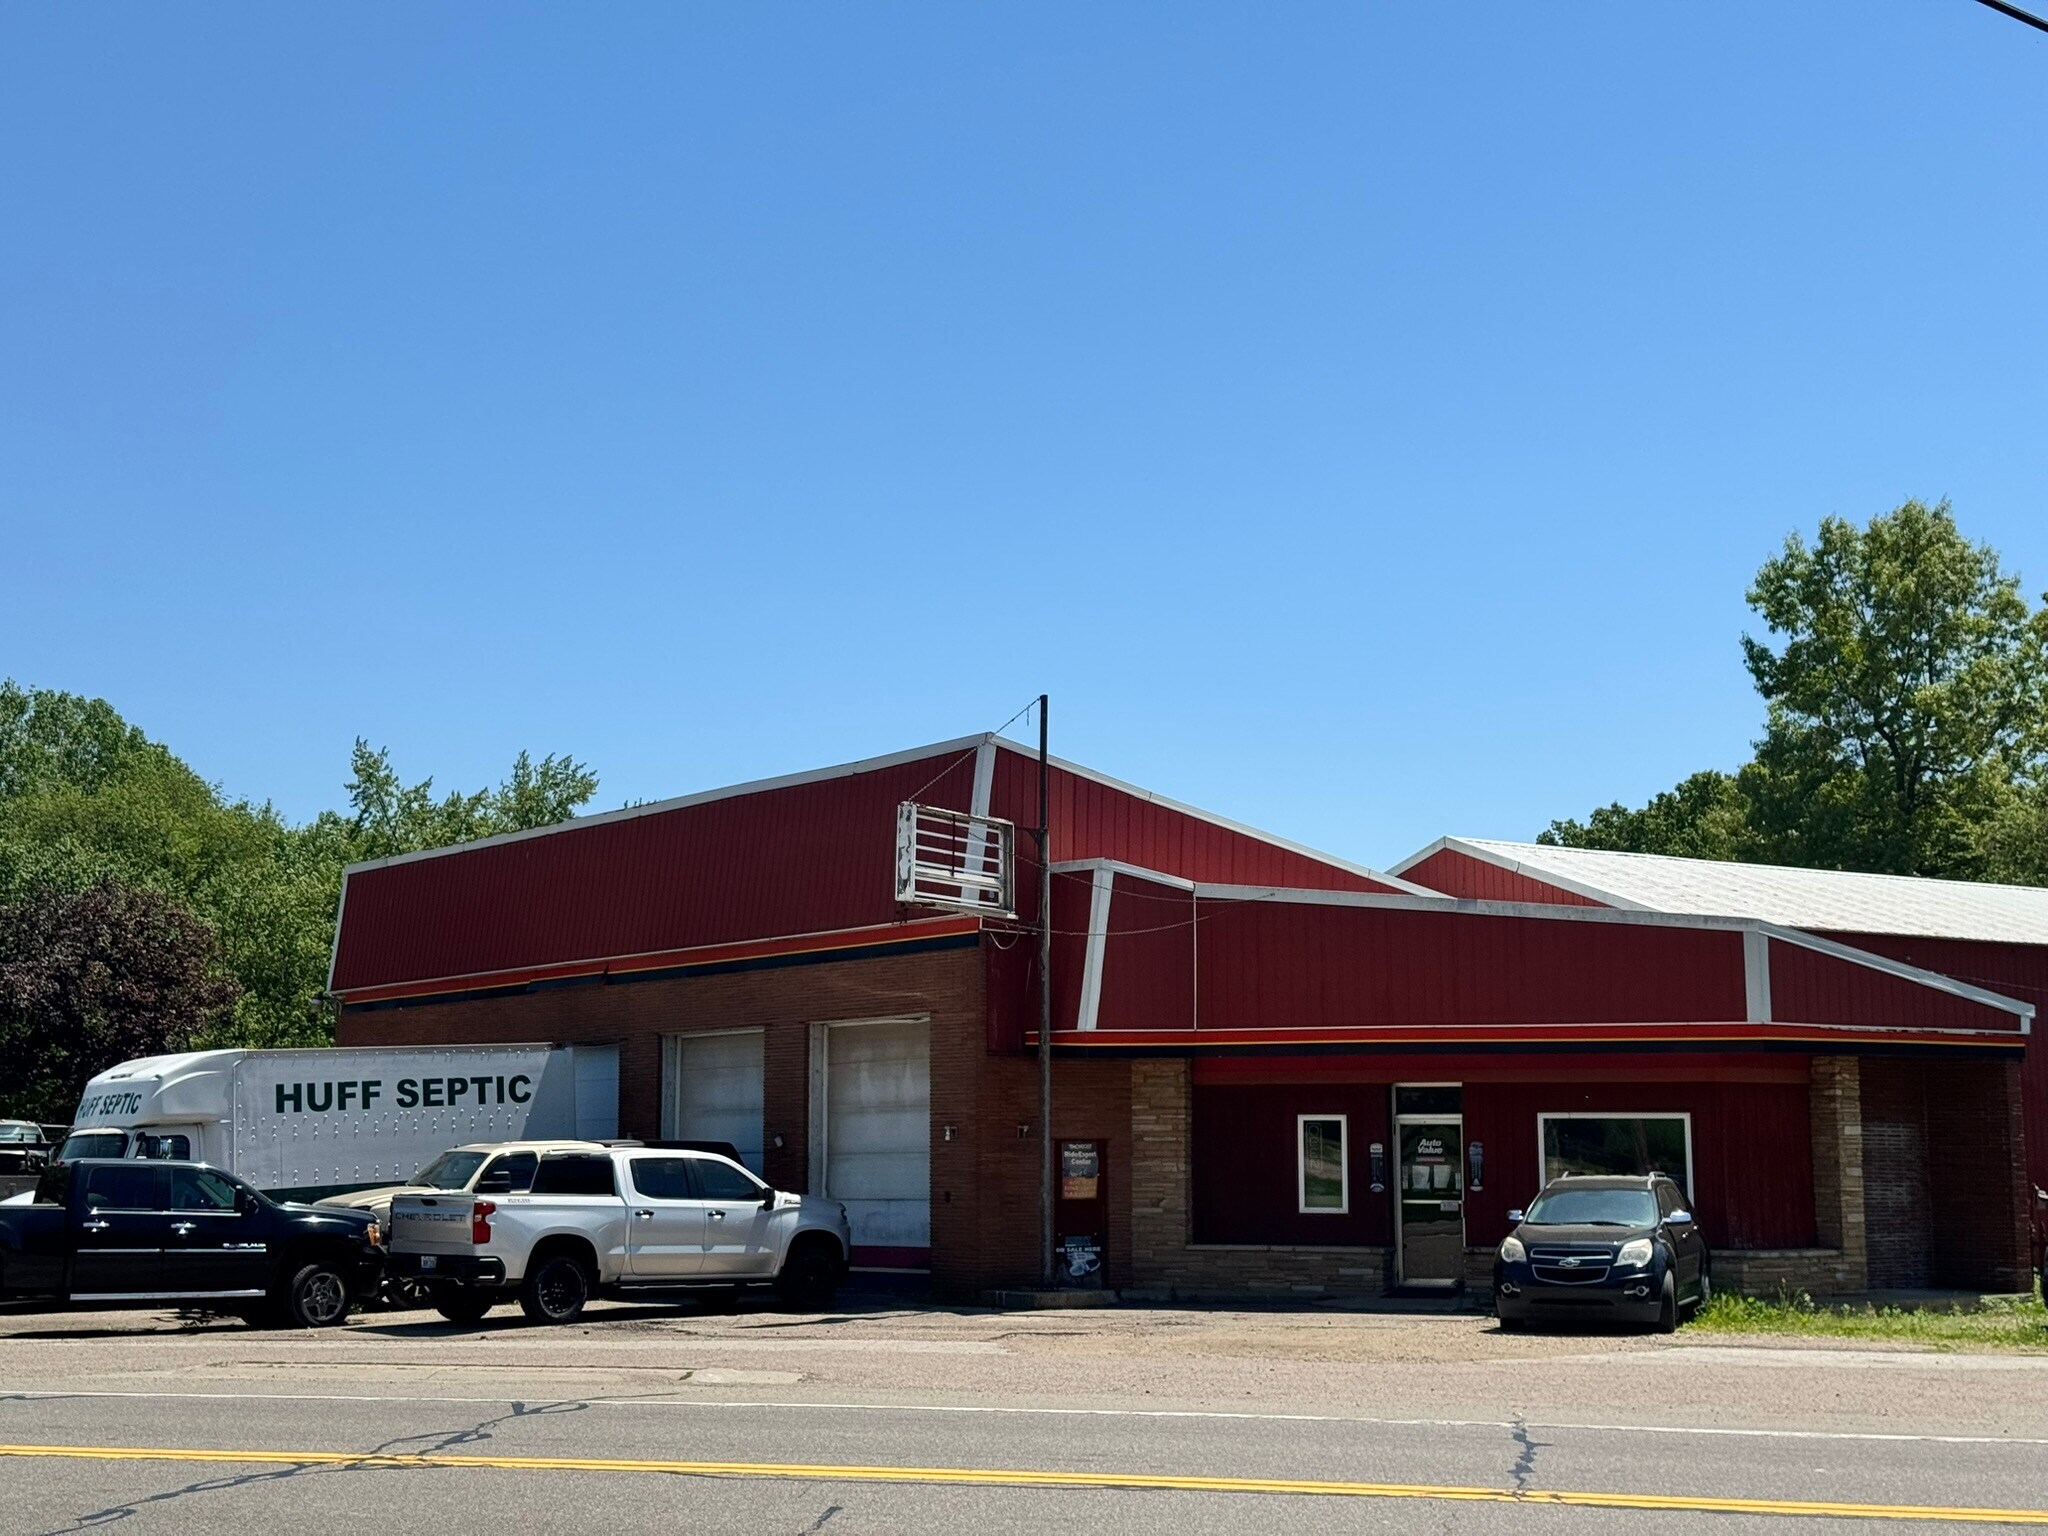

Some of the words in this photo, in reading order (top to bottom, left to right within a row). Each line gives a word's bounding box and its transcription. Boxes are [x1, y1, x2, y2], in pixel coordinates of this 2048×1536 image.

[276, 1080, 382, 1113] HUFF
[396, 1074, 532, 1108] SEPTIC
[99, 1092, 142, 1115] SEPTIC
[1419, 1138, 1442, 1147] Auto
[1417, 1145, 1443, 1154] Value
[395, 1212, 466, 1222] CHEVROLET
